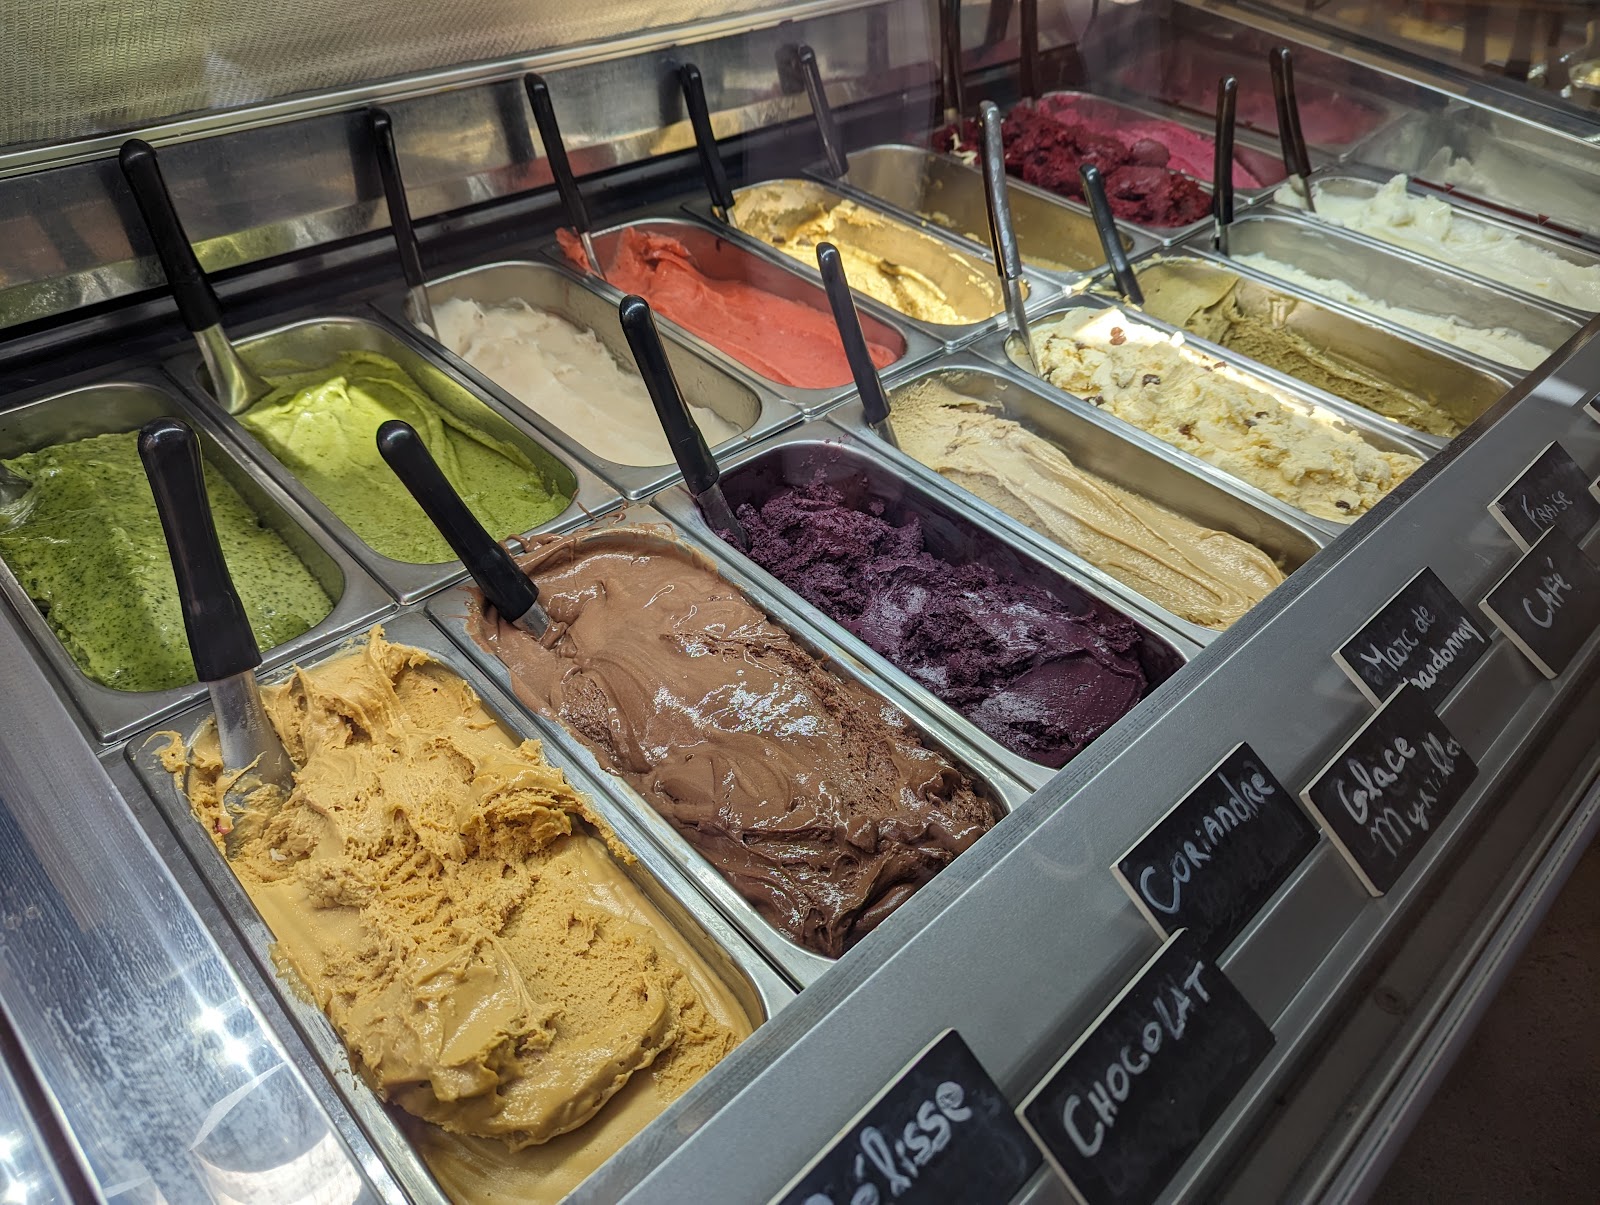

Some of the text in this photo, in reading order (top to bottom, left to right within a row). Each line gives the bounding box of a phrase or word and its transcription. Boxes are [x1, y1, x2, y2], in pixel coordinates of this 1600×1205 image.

[1360, 605, 1436, 672] Marc de
[1337, 736, 1417, 825] Glace
